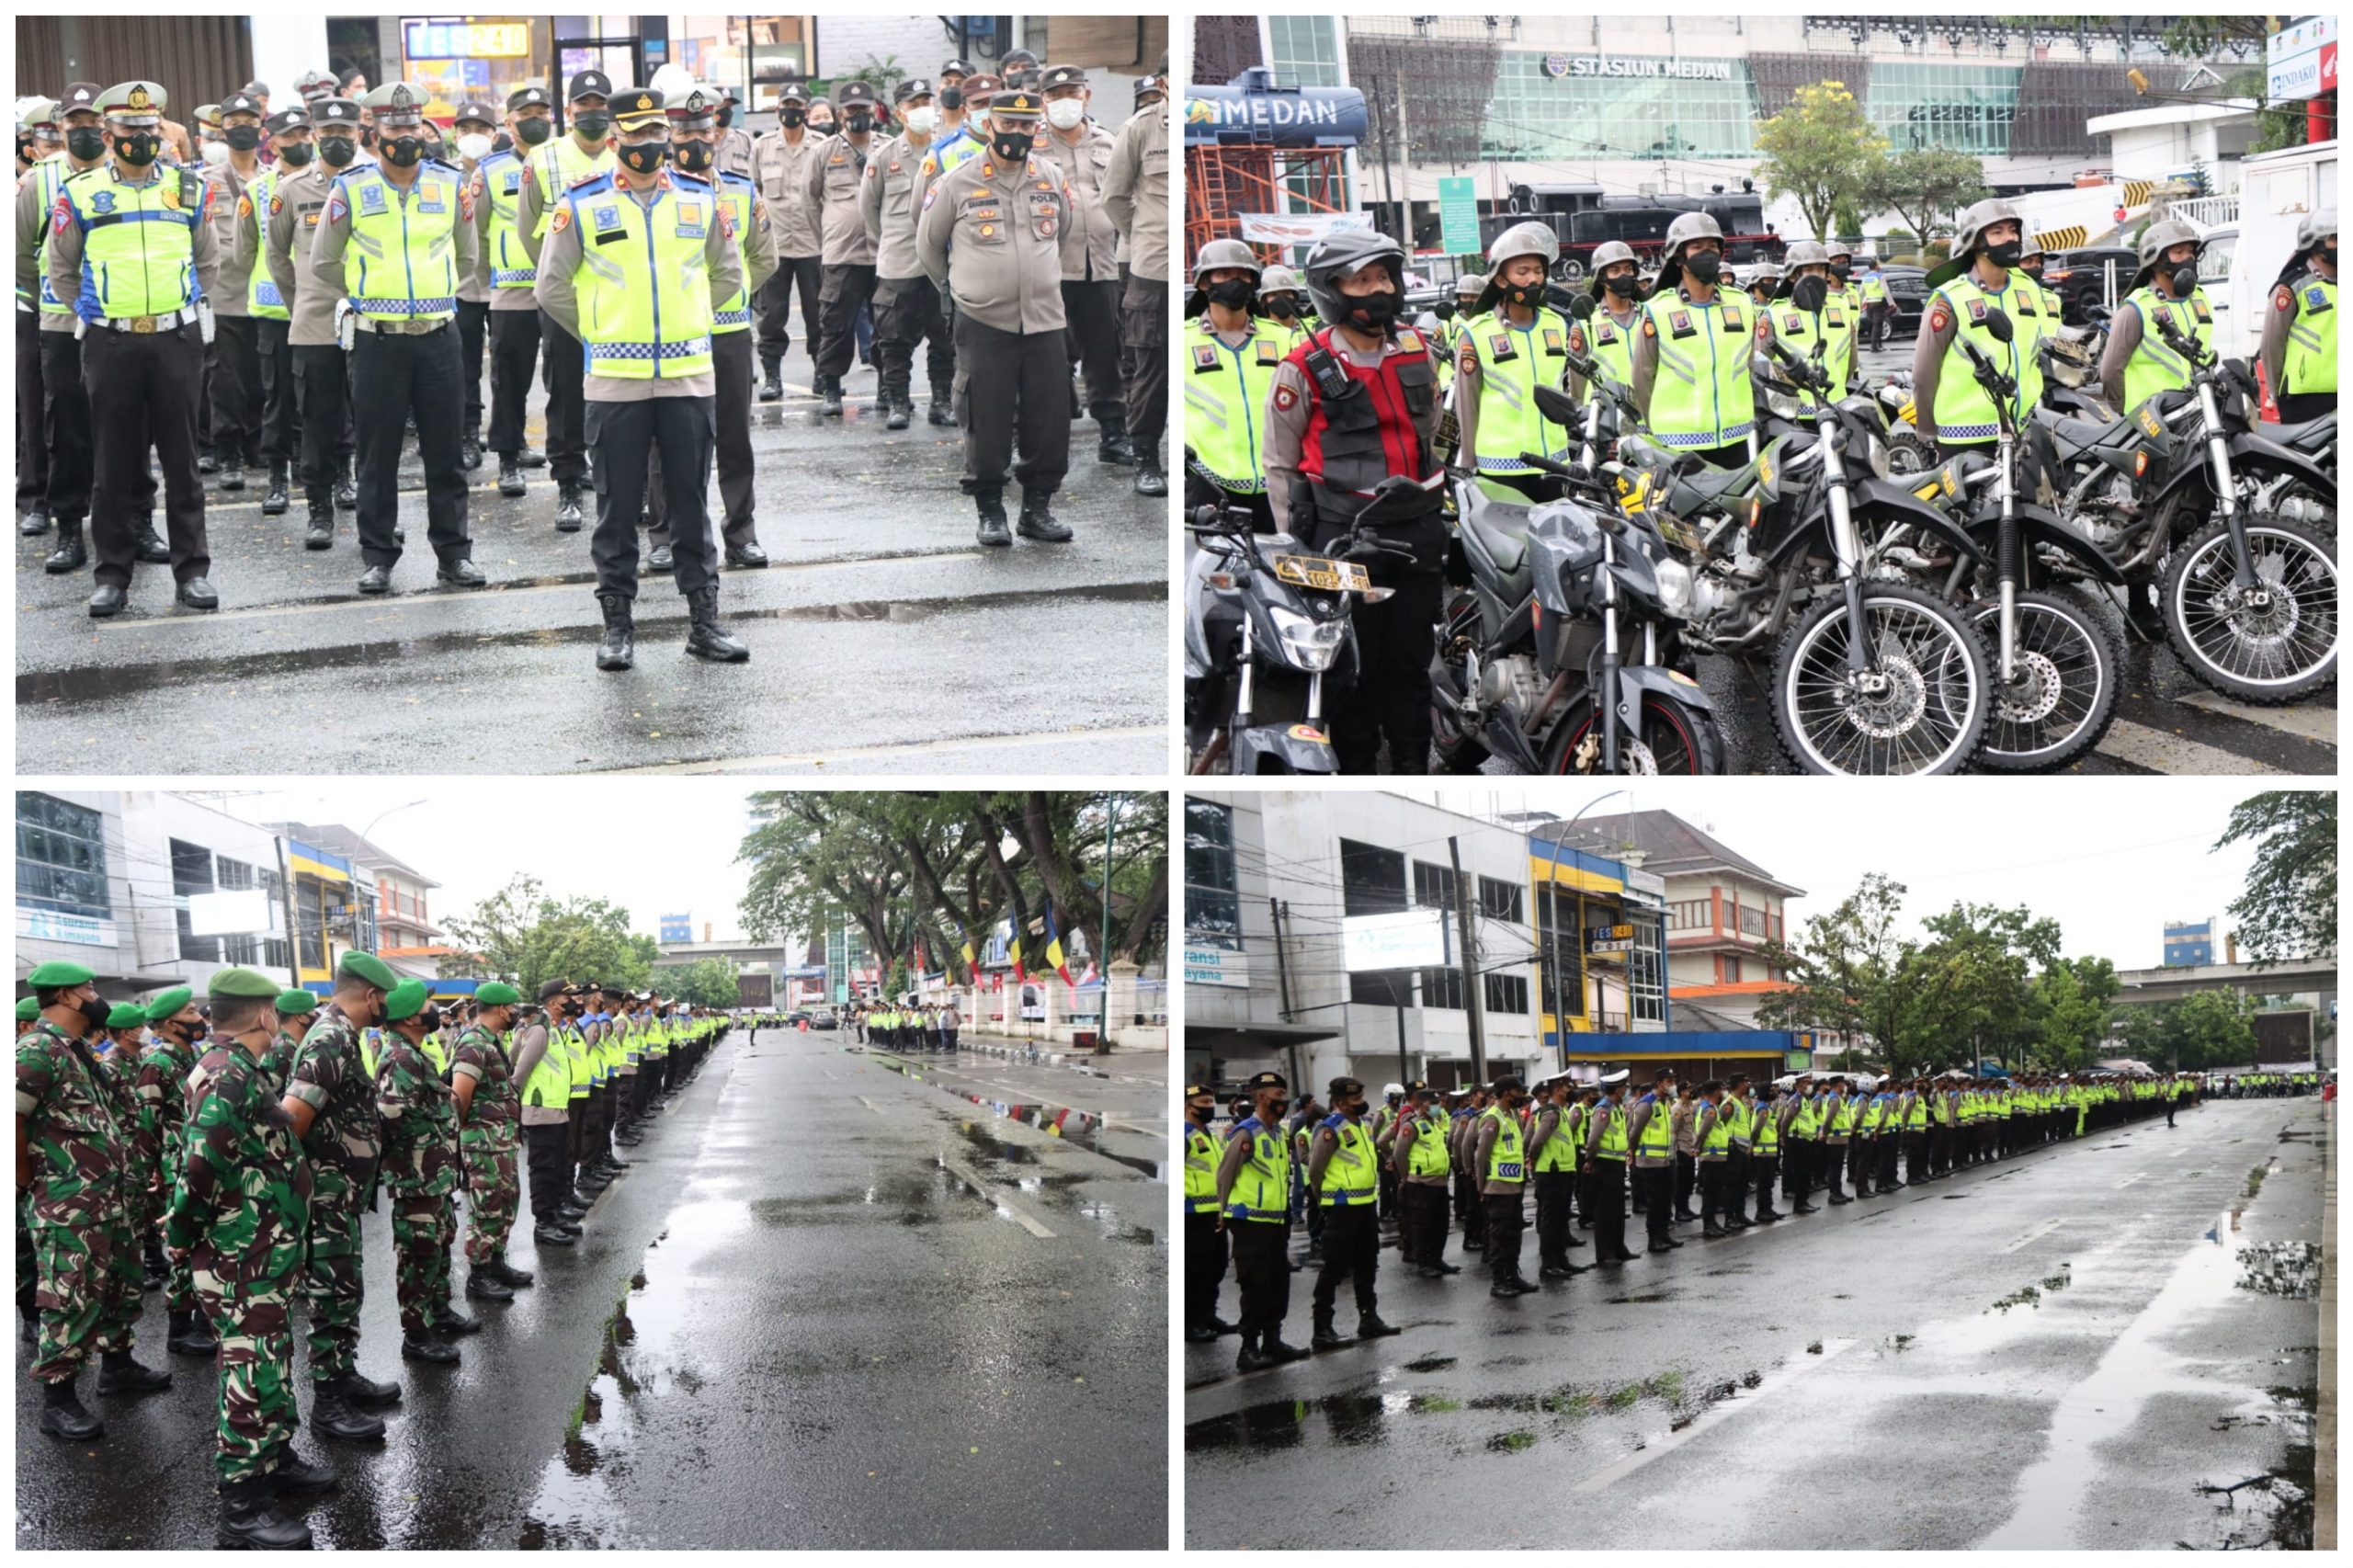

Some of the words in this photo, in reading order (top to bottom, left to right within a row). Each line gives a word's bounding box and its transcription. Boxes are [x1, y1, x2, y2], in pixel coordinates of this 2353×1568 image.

[410, 26, 465, 56] YES
[1573, 58, 1659, 77] STASIUN
[1665, 61, 1731, 79] MEDAN
[2281, 63, 2316, 88] INDAKO
[1223, 99, 1337, 124] MEDAN
[2139, 408, 2162, 437] POLISI
[1592, 926, 1611, 939] YES
